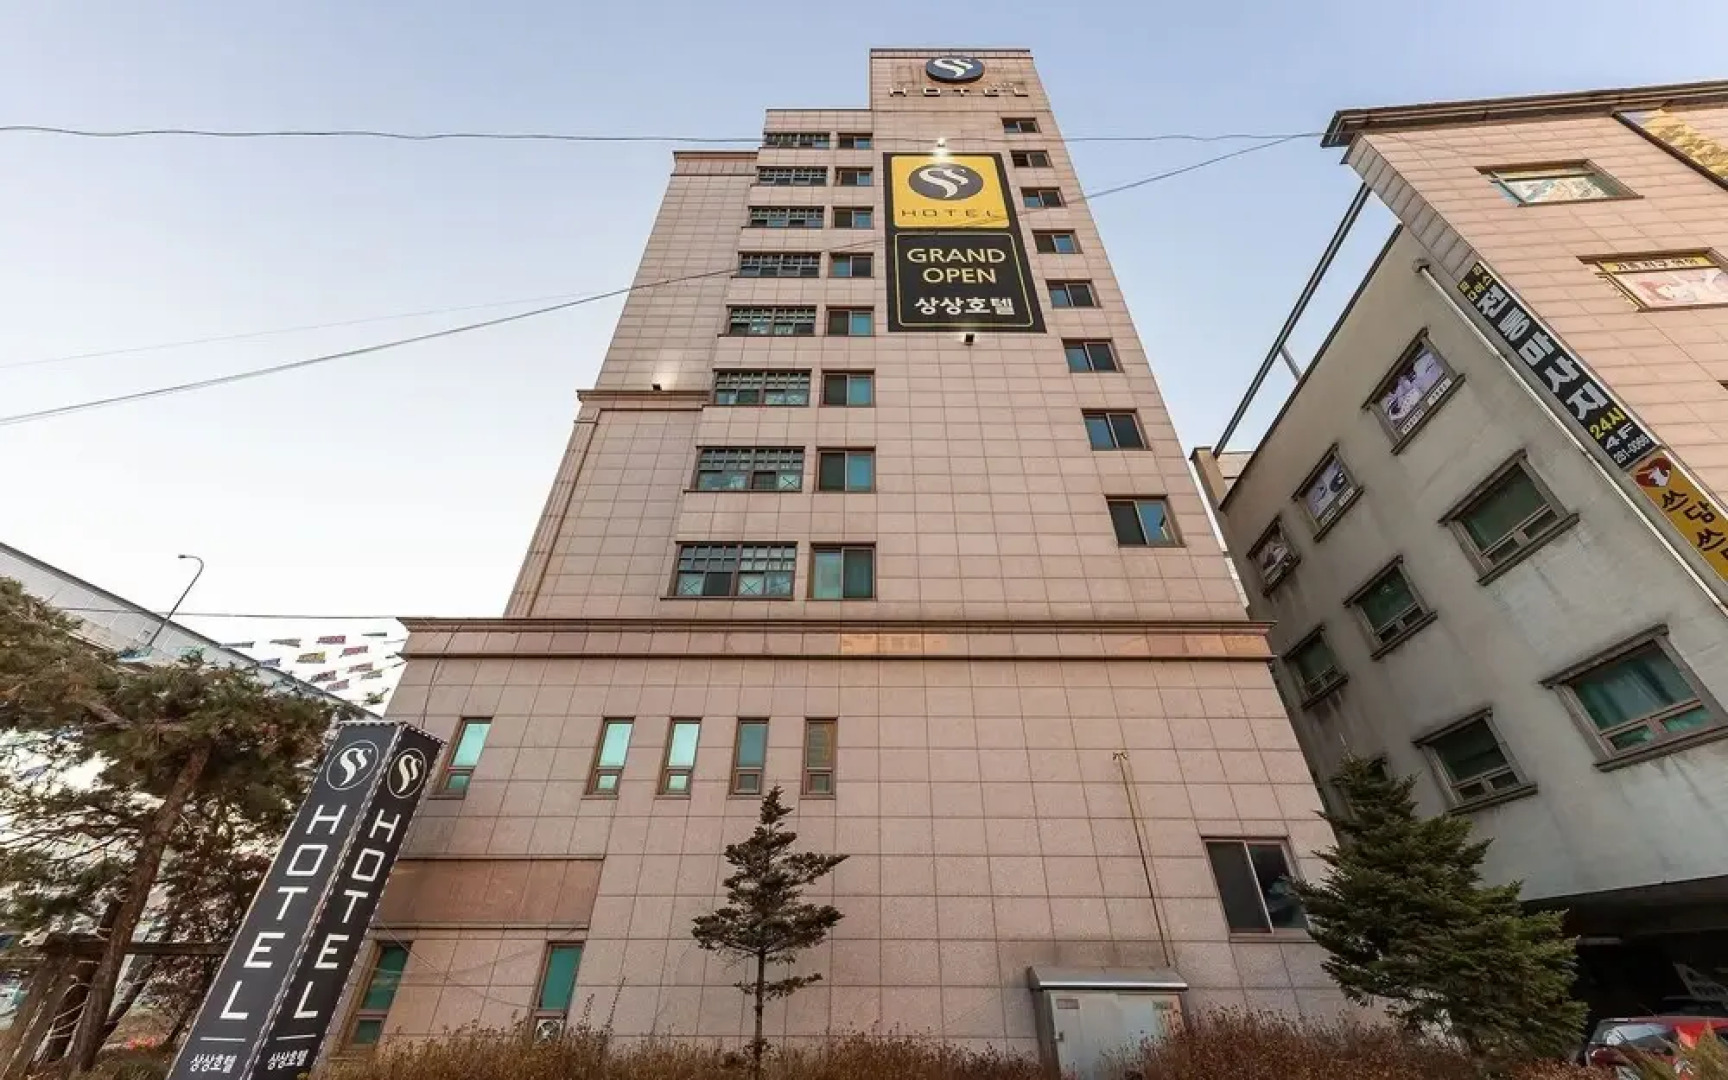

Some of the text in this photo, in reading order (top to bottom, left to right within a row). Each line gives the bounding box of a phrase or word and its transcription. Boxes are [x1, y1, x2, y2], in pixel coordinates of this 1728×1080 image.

[889, 87, 1029, 97] HOTEL
[902, 209, 1000, 217] HOTEL
[906, 248, 1006, 263] GRAND
[923, 267, 997, 283] OPEN
[914, 297, 1015, 315] 상상호텔
[1476, 285, 1608, 420] 전통마사지
[1590, 407, 1626, 439] 24시
[1606, 422, 1633, 449] 4F
[219, 804, 347, 1020] HOTEL
[293, 809, 401, 1019] HOTEL
[190, 1053, 237, 1073] 상상호텔
[268, 1049, 309, 1070] 상상호텔
